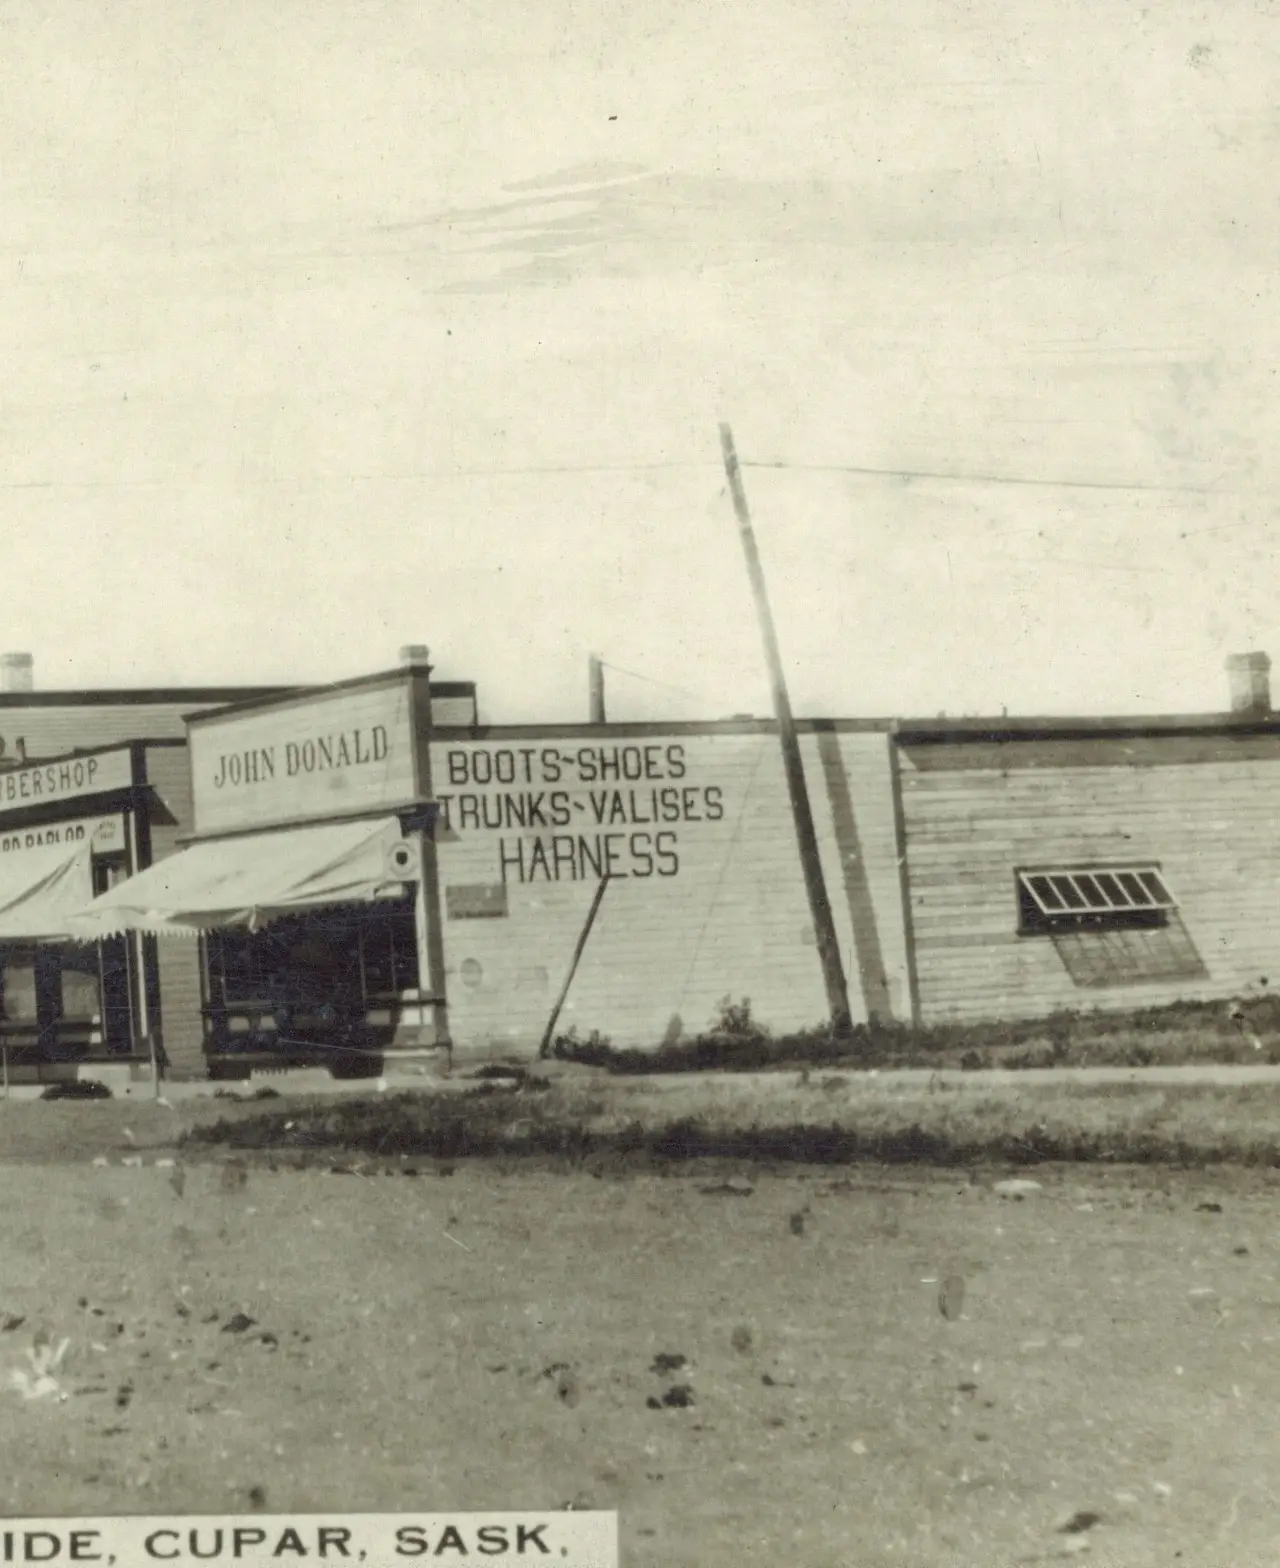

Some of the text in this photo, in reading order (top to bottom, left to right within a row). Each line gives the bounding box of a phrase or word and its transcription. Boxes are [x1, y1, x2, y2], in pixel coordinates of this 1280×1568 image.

[214, 724, 390, 789] JOHN DONALD
[498, 830, 680, 883] HARNESS
